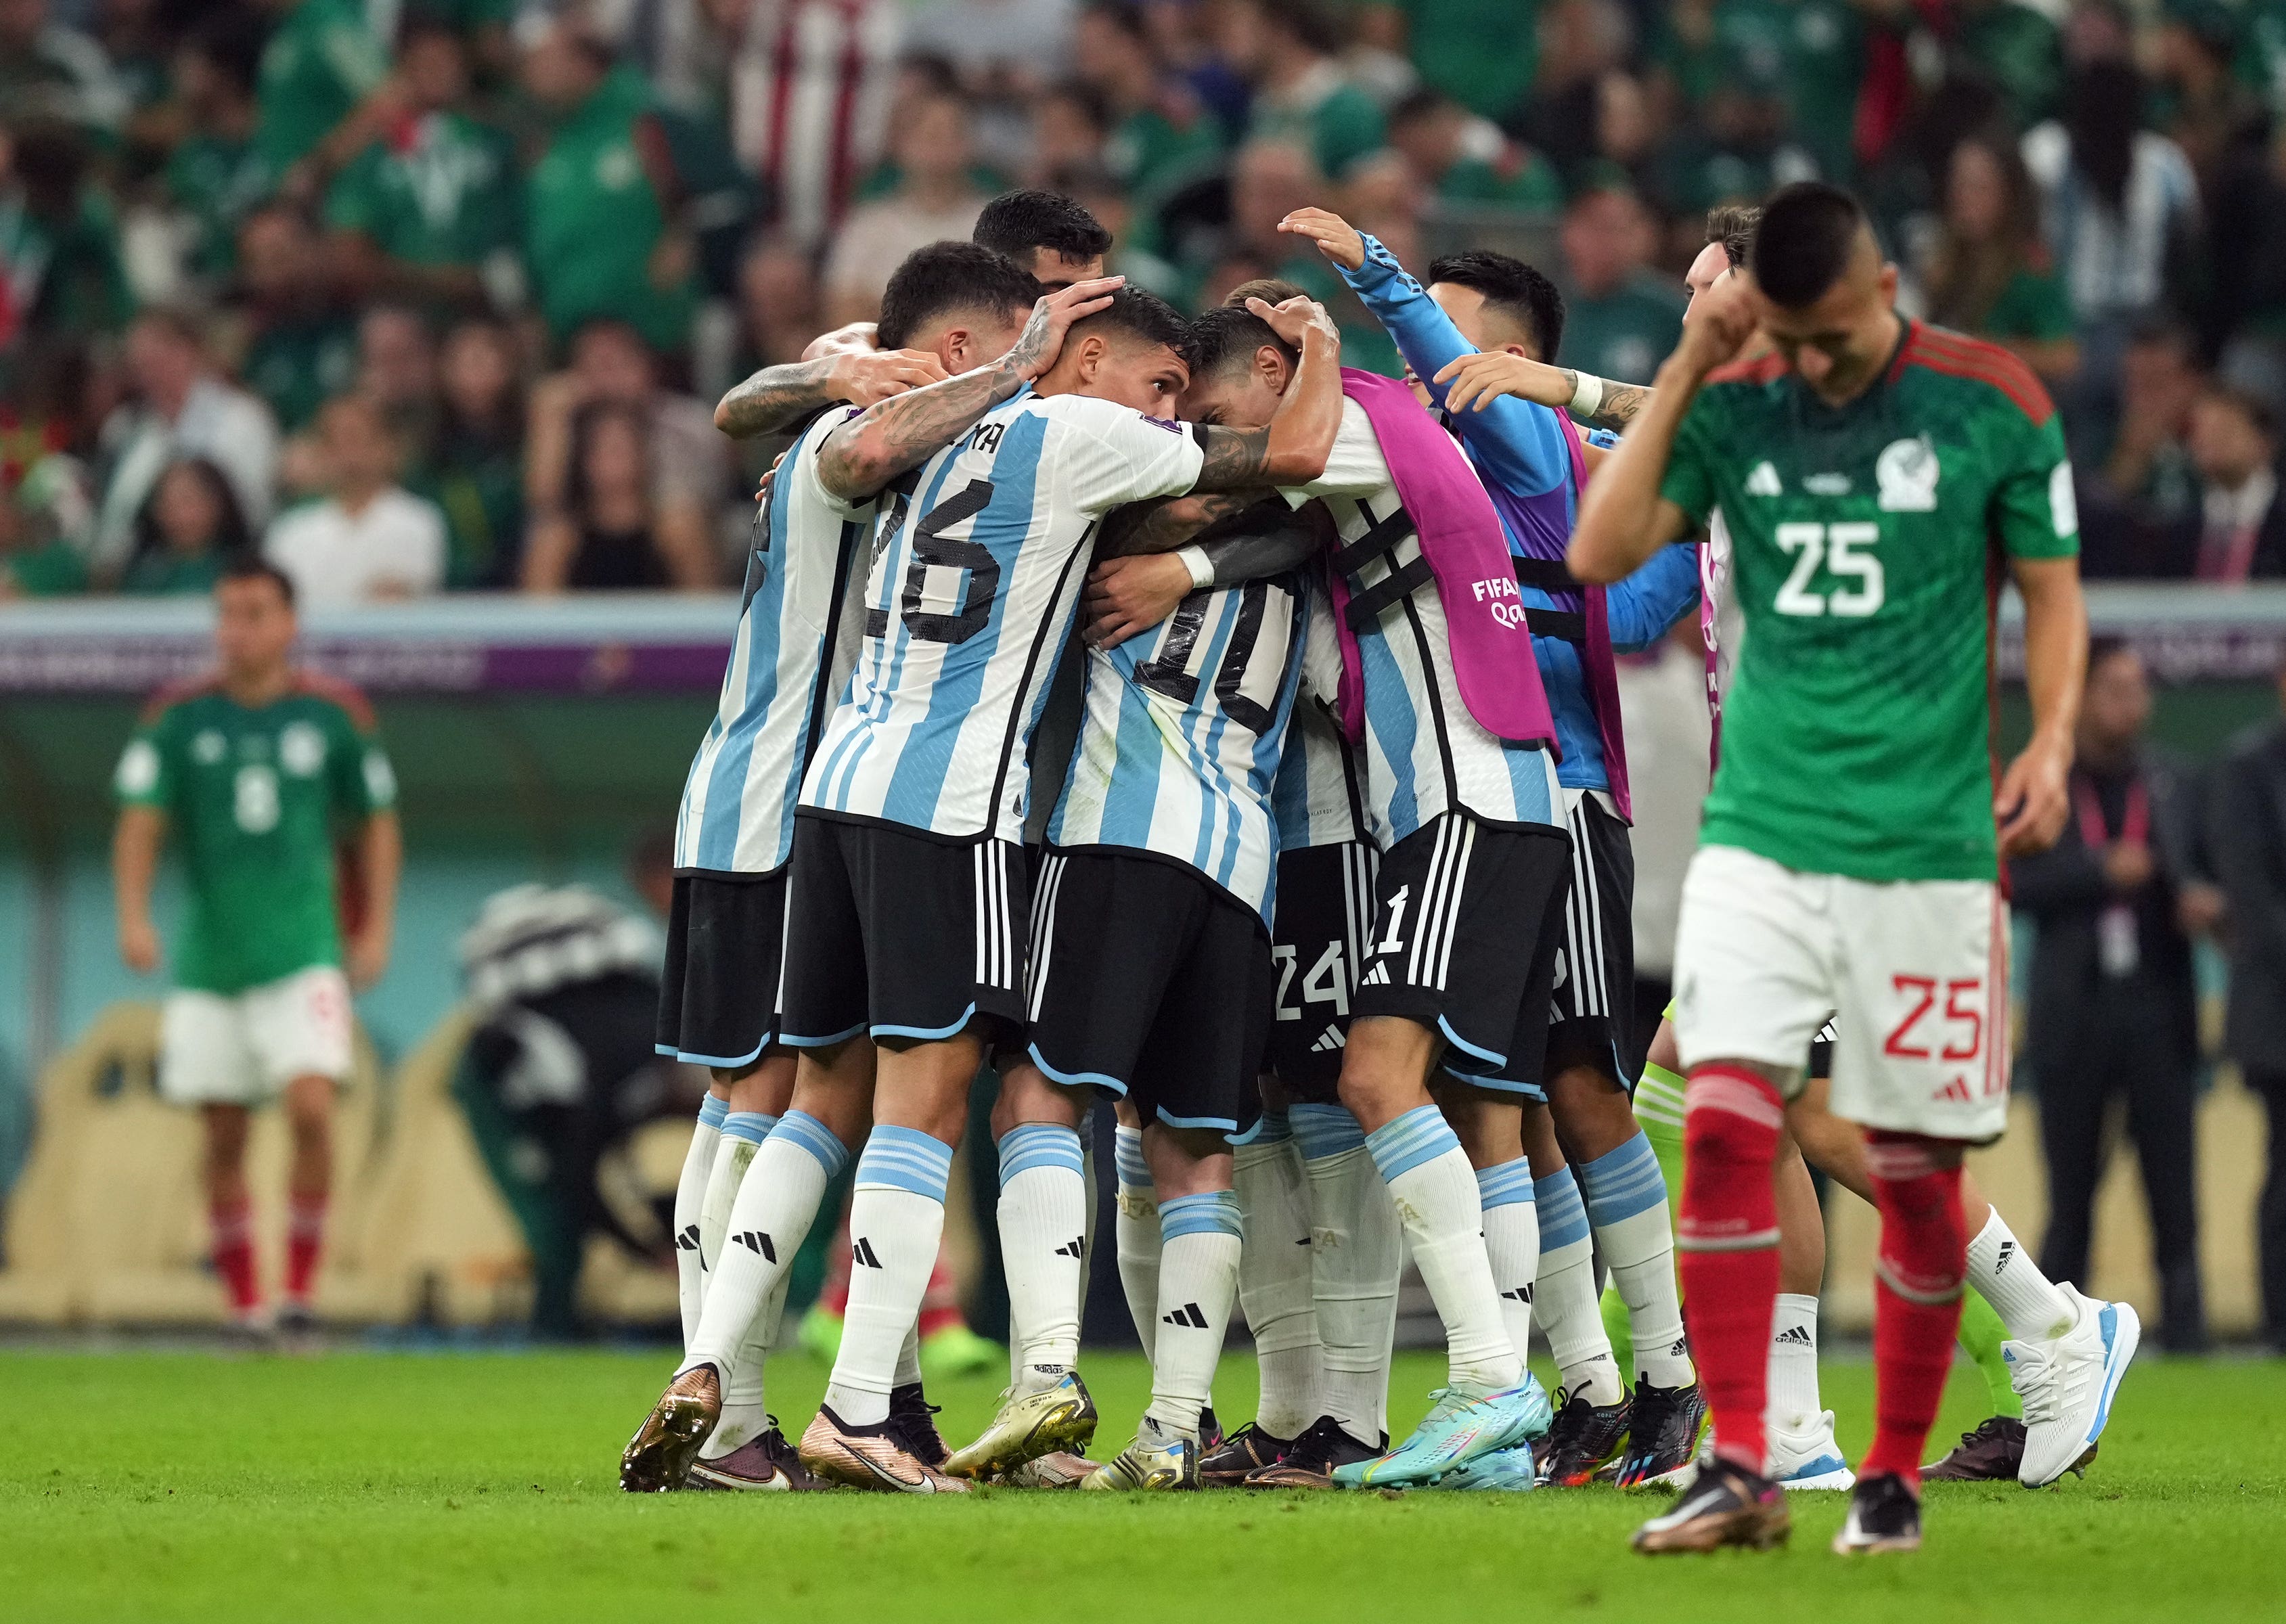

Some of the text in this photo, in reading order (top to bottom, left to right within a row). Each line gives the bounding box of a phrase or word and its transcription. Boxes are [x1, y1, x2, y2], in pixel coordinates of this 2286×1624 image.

[862, 471, 1001, 645] 26
[1471, 577, 1518, 602] FIFA
[1774, 522, 1885, 618] 25
[1491, 602, 1526, 630] Qa
[1131, 579, 1303, 738] 10
[1363, 884, 1410, 962] 1
[1272, 939, 1350, 1021] 24
[1885, 973, 1981, 1062] 25
[1995, 1241, 2016, 1276] adidas
[1034, 1363, 1064, 1374] adidas
[1775, 1336, 1813, 1348] adidas
